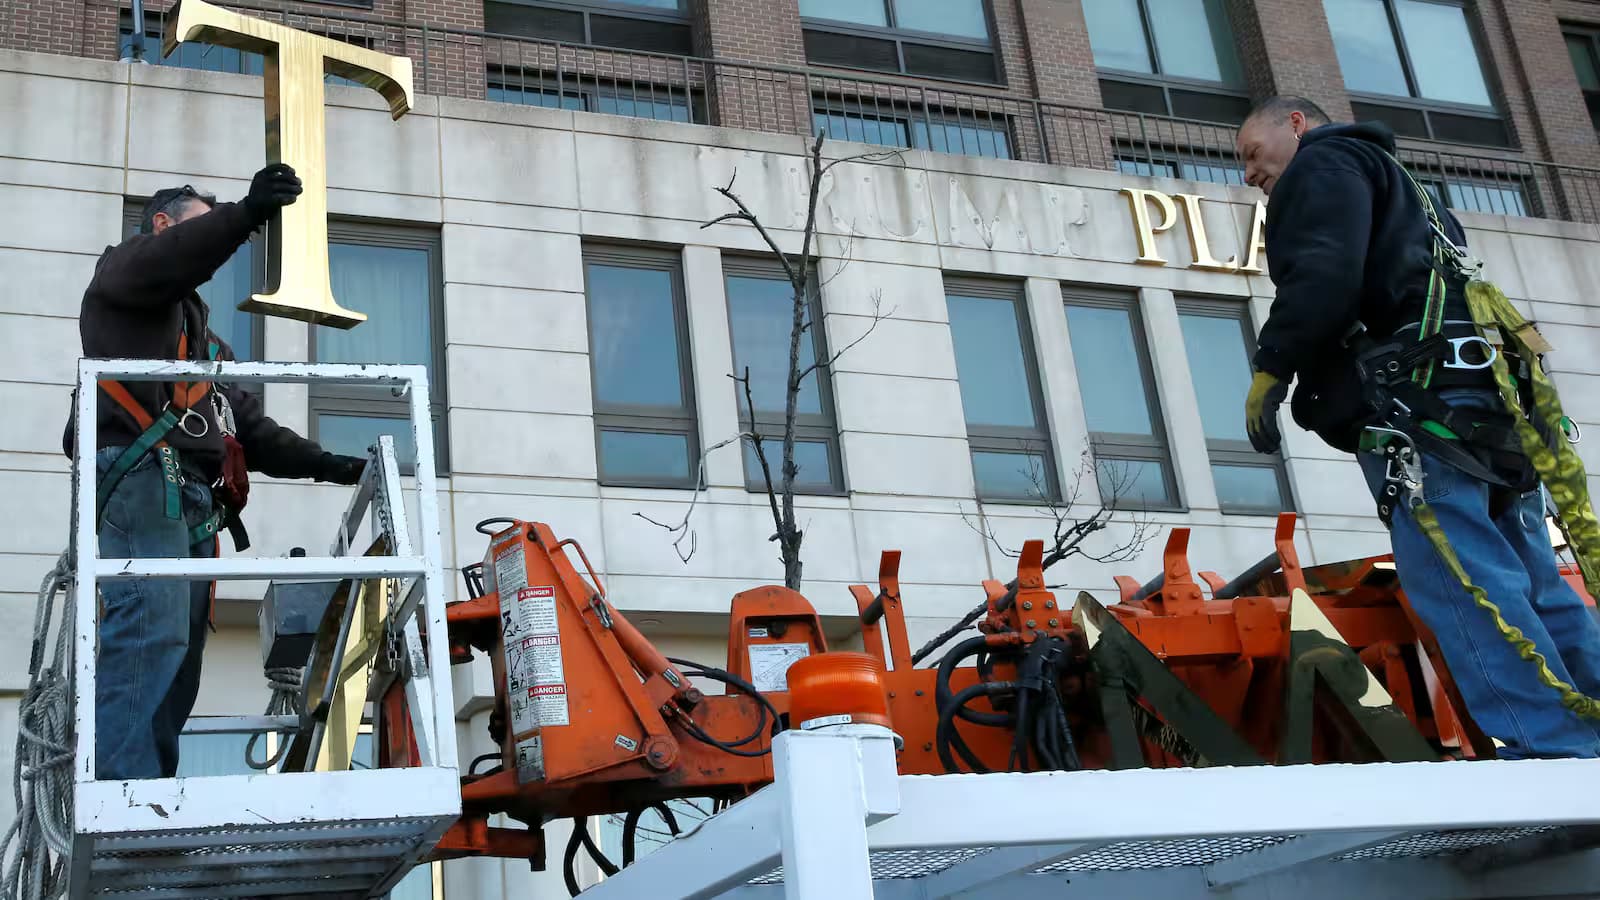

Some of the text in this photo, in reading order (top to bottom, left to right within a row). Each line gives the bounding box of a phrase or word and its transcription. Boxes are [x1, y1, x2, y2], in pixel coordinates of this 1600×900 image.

[163, 0, 413, 328] T
[705, 147, 1091, 257] RUMP
[525, 589, 550, 598] DANGER
[527, 636, 557, 646] DANGER
[534, 686, 563, 694] DANGER
